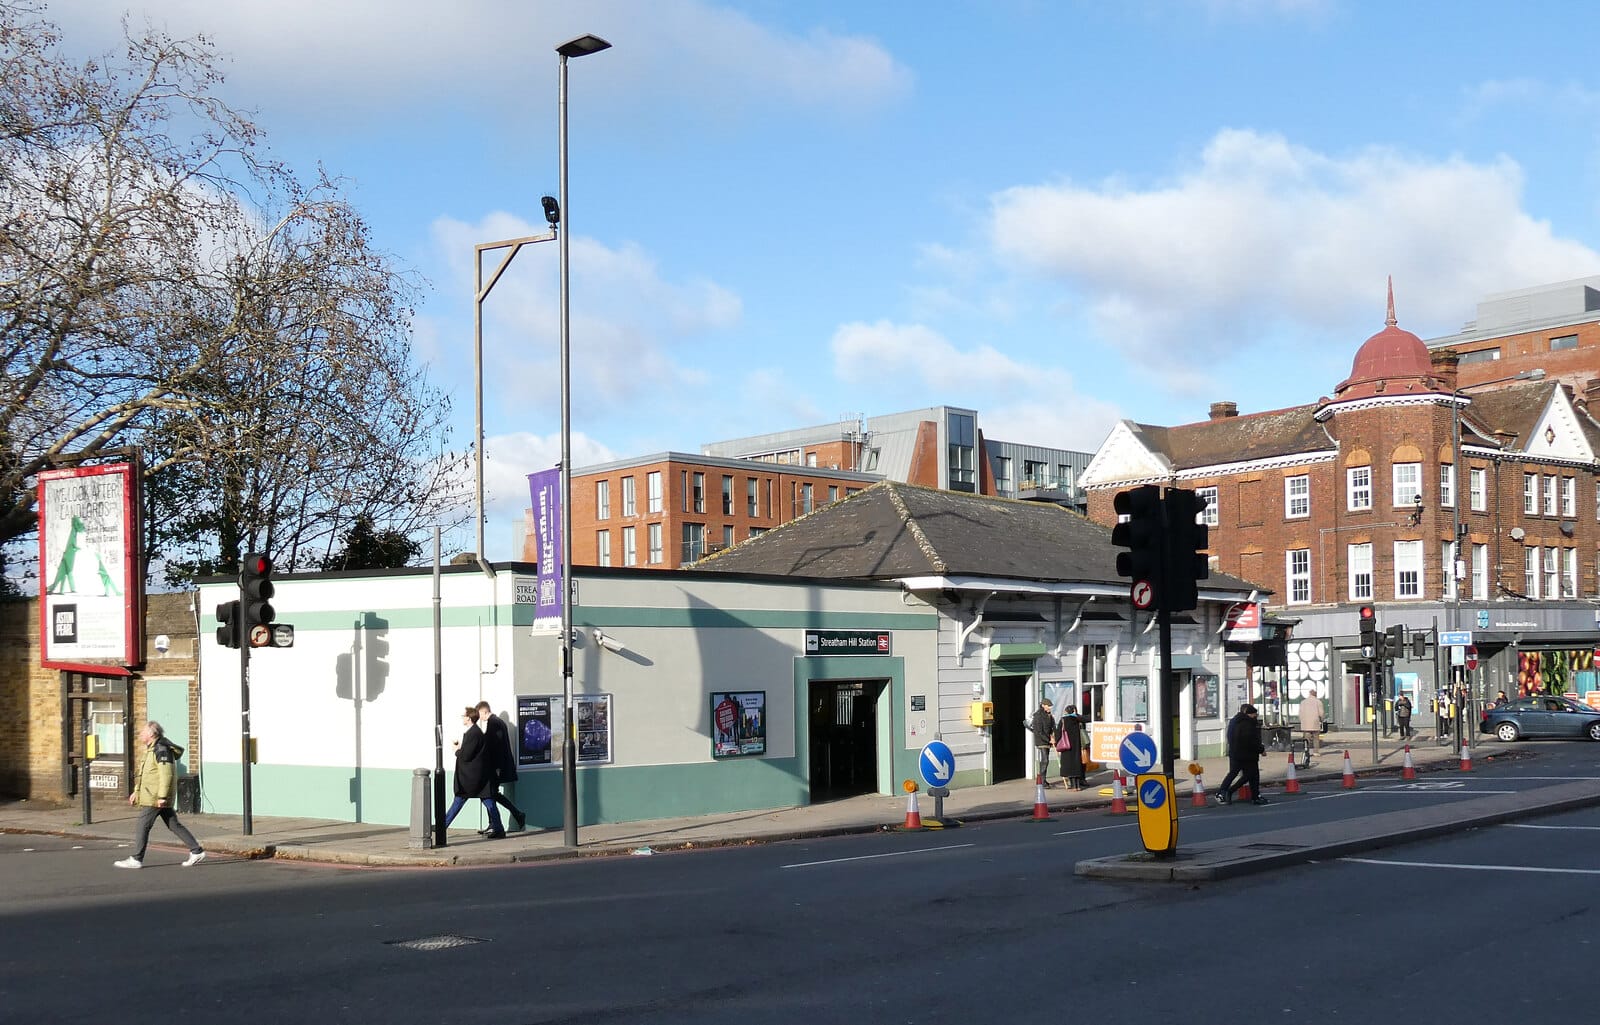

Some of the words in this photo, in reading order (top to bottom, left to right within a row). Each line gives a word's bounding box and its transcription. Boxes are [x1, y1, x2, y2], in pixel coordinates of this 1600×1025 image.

[68, 485, 90, 502] LOOK
[92, 483, 118, 500] AFTER
[540, 486, 548, 575] Streatham
[516, 585, 537, 594] STREA
[516, 594, 536, 603] ROAD
[820, 637, 848, 647] Streatham
[848, 637, 857, 647] Hill
[858, 637, 877, 647] Station
